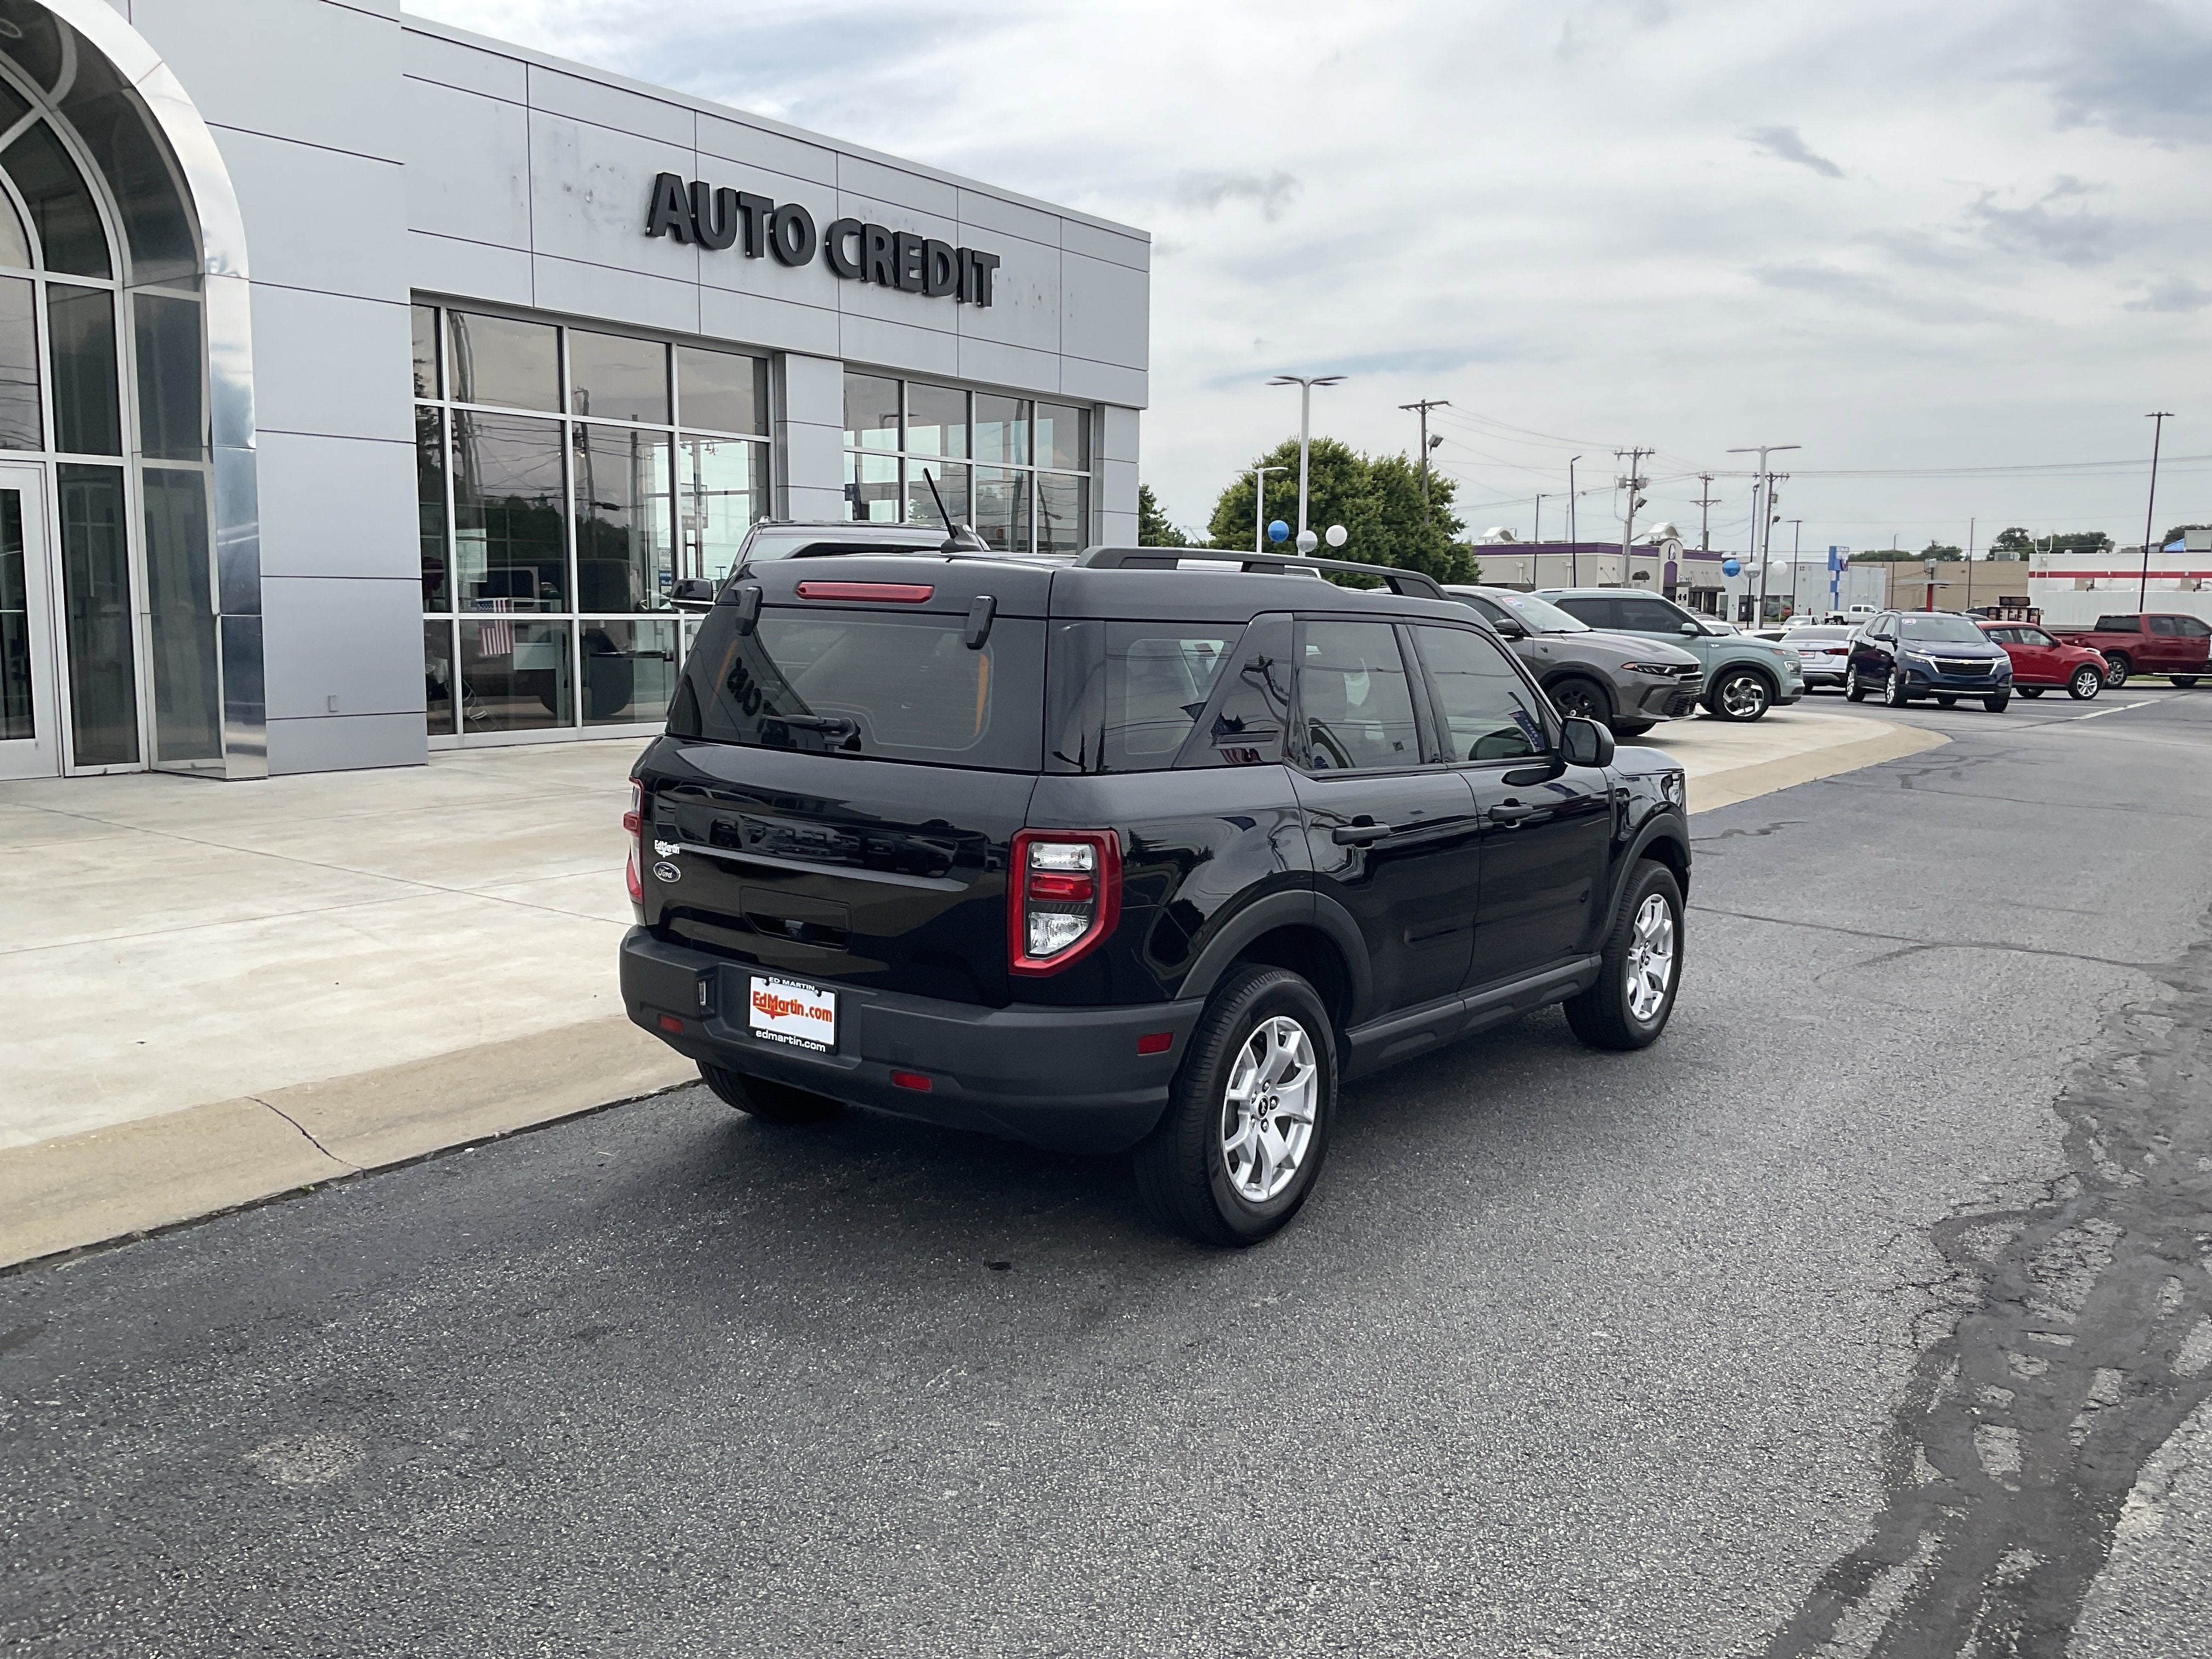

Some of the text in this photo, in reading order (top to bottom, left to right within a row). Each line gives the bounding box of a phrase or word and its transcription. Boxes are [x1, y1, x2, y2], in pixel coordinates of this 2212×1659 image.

[646, 172, 1000, 307] AUTO CREDIT
[654, 839, 680, 855] EdMartin
[658, 865, 673, 879] Ford
[782, 979, 815, 991] MARTIN
[753, 990, 832, 1023] EdMartin.com
[755, 1030, 826, 1052] edmartin.com
